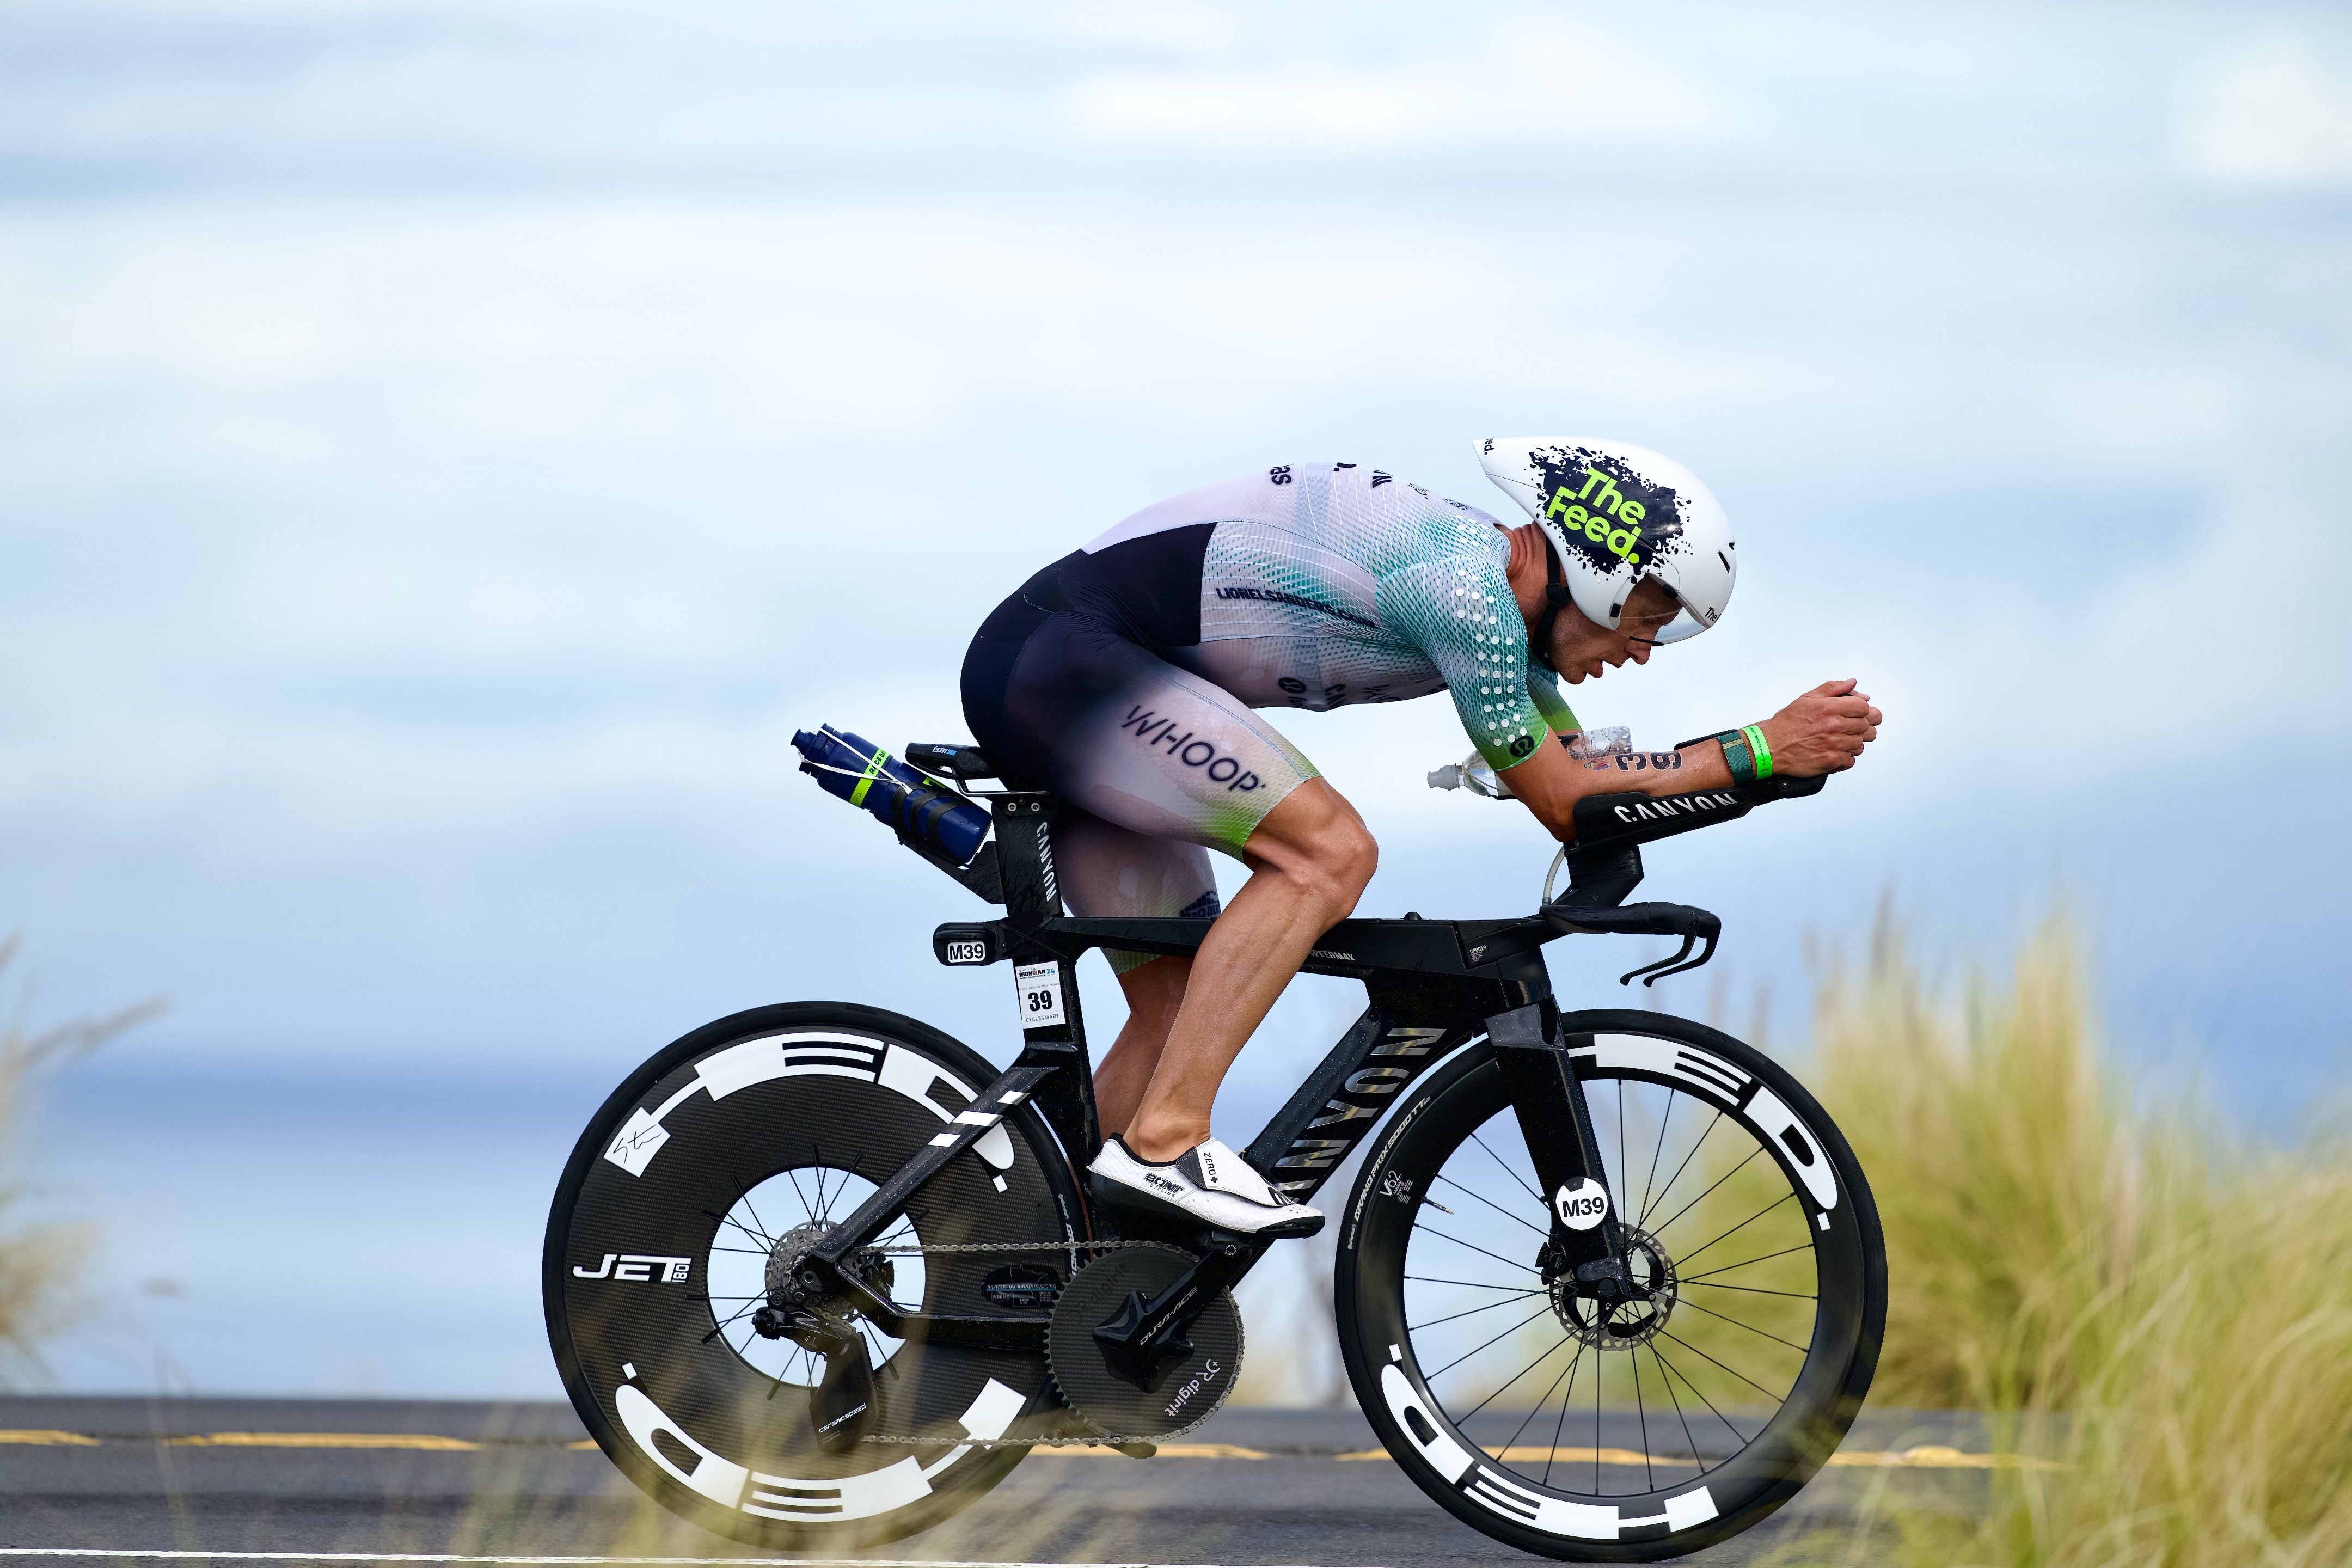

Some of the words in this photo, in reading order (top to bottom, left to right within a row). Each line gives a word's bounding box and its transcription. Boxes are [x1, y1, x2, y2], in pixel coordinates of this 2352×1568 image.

[1484, 438, 1494, 455] ed.
[1578, 467, 1645, 525] The
[1546, 486, 1640, 564] Feed.
[1705, 607, 1717, 621] The
[932, 745, 948, 754] ism
[1614, 793, 1738, 823] CANYON
[1037, 822, 1057, 902] CANYON
[950, 944, 984, 960] M39
[1019, 969, 1046, 977] IRONMAN
[1028, 990, 1052, 1012] 39
[1026, 1013, 1059, 1022] CYCLESMART
[1144, 1172, 1185, 1194] BONT
[1150, 1183, 1175, 1197] CYCLING
[1562, 1197, 1604, 1217] M39
[573, 1254, 691, 1282] JET
[672, 1264, 690, 1283] 180
[1140, 1286, 1197, 1346] DURA-ACE
[1165, 1380, 1199, 1417] digirit
[819, 1402, 866, 1433] ceramicspeed
